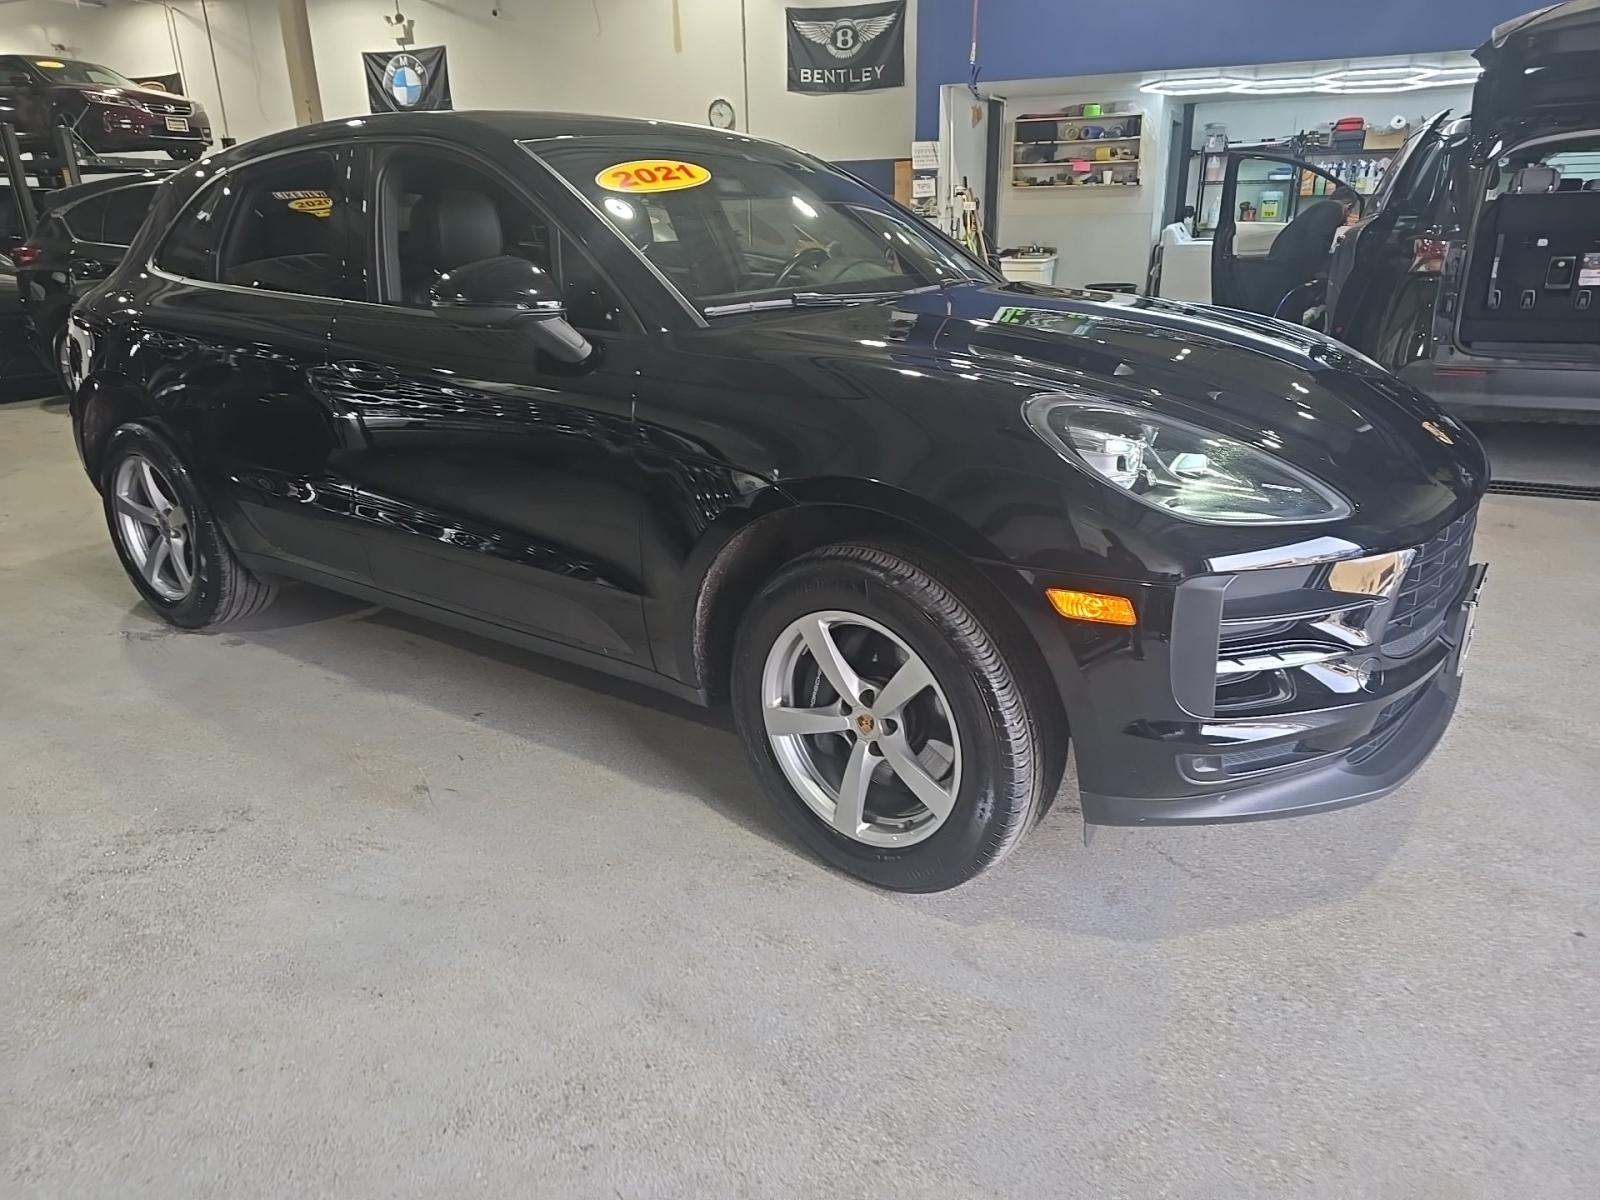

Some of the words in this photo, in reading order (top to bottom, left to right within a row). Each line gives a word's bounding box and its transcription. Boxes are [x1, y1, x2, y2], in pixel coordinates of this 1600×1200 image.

[836, 28, 854, 49] B
[386, 56, 424, 77] BMW
[800, 64, 885, 83] BENTLEY
[612, 165, 696, 188] 2021
